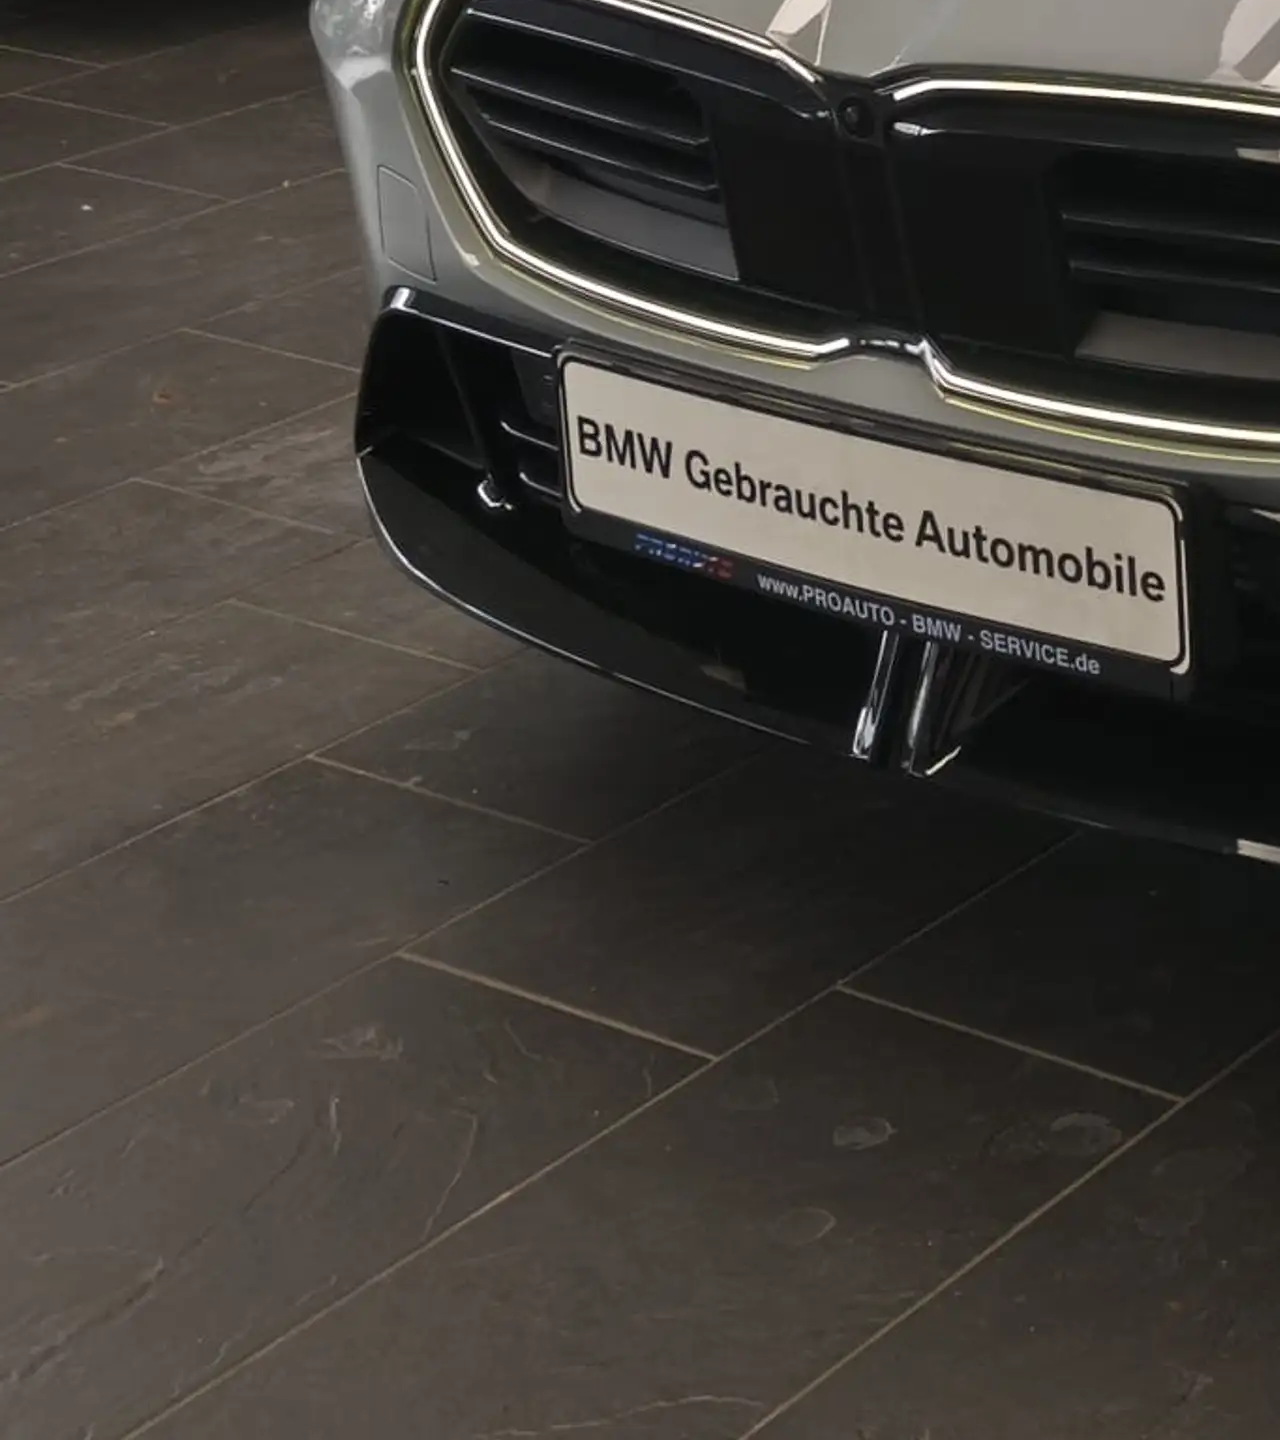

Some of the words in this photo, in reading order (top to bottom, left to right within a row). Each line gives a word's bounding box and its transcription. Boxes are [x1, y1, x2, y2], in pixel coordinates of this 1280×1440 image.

[577, 415, 673, 480] BMW
[684, 449, 905, 543] Gebrauchte
[915, 510, 1166, 603] Automobile
[757, 573, 895, 626] www.PROAUTO
[912, 613, 962, 643] BMW
[980, 629, 1101, 675] SERVICE.de
